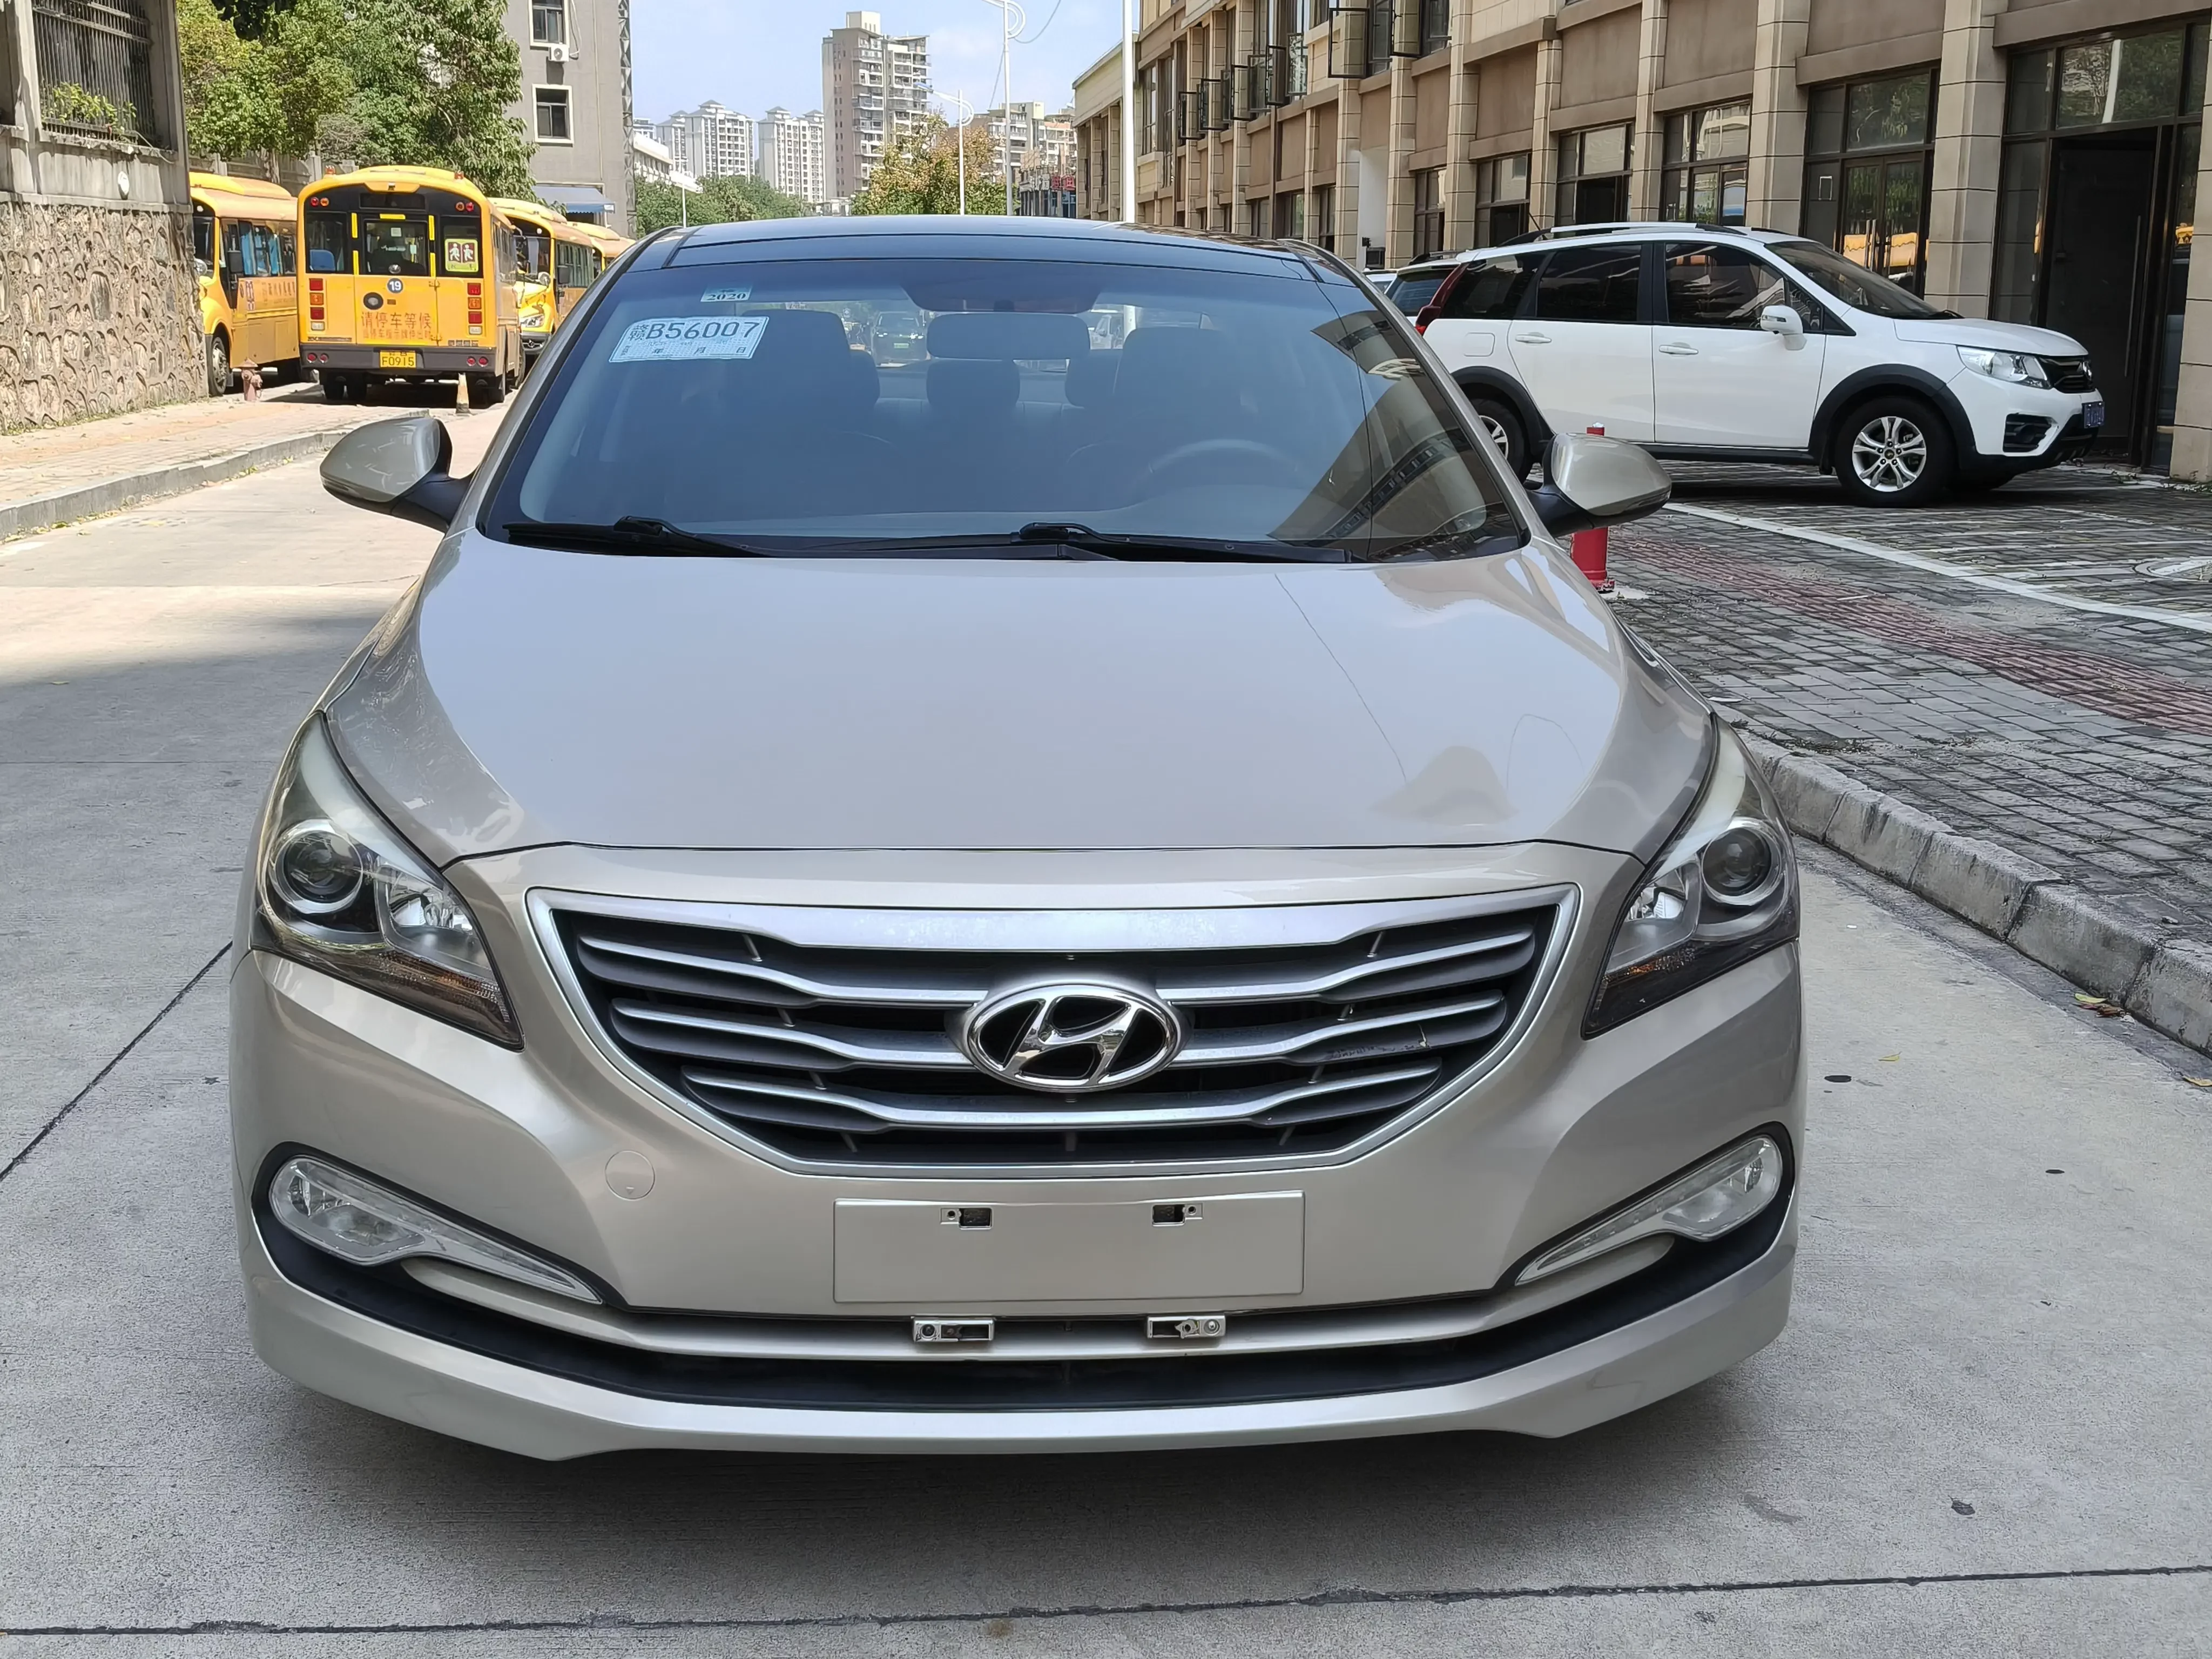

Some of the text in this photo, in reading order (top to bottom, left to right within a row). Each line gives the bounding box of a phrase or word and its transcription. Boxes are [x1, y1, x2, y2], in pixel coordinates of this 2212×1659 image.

[389, 281, 402, 291] 19
[361, 312, 431, 329] 请停车等候
[382, 356, 414, 366] F0915
